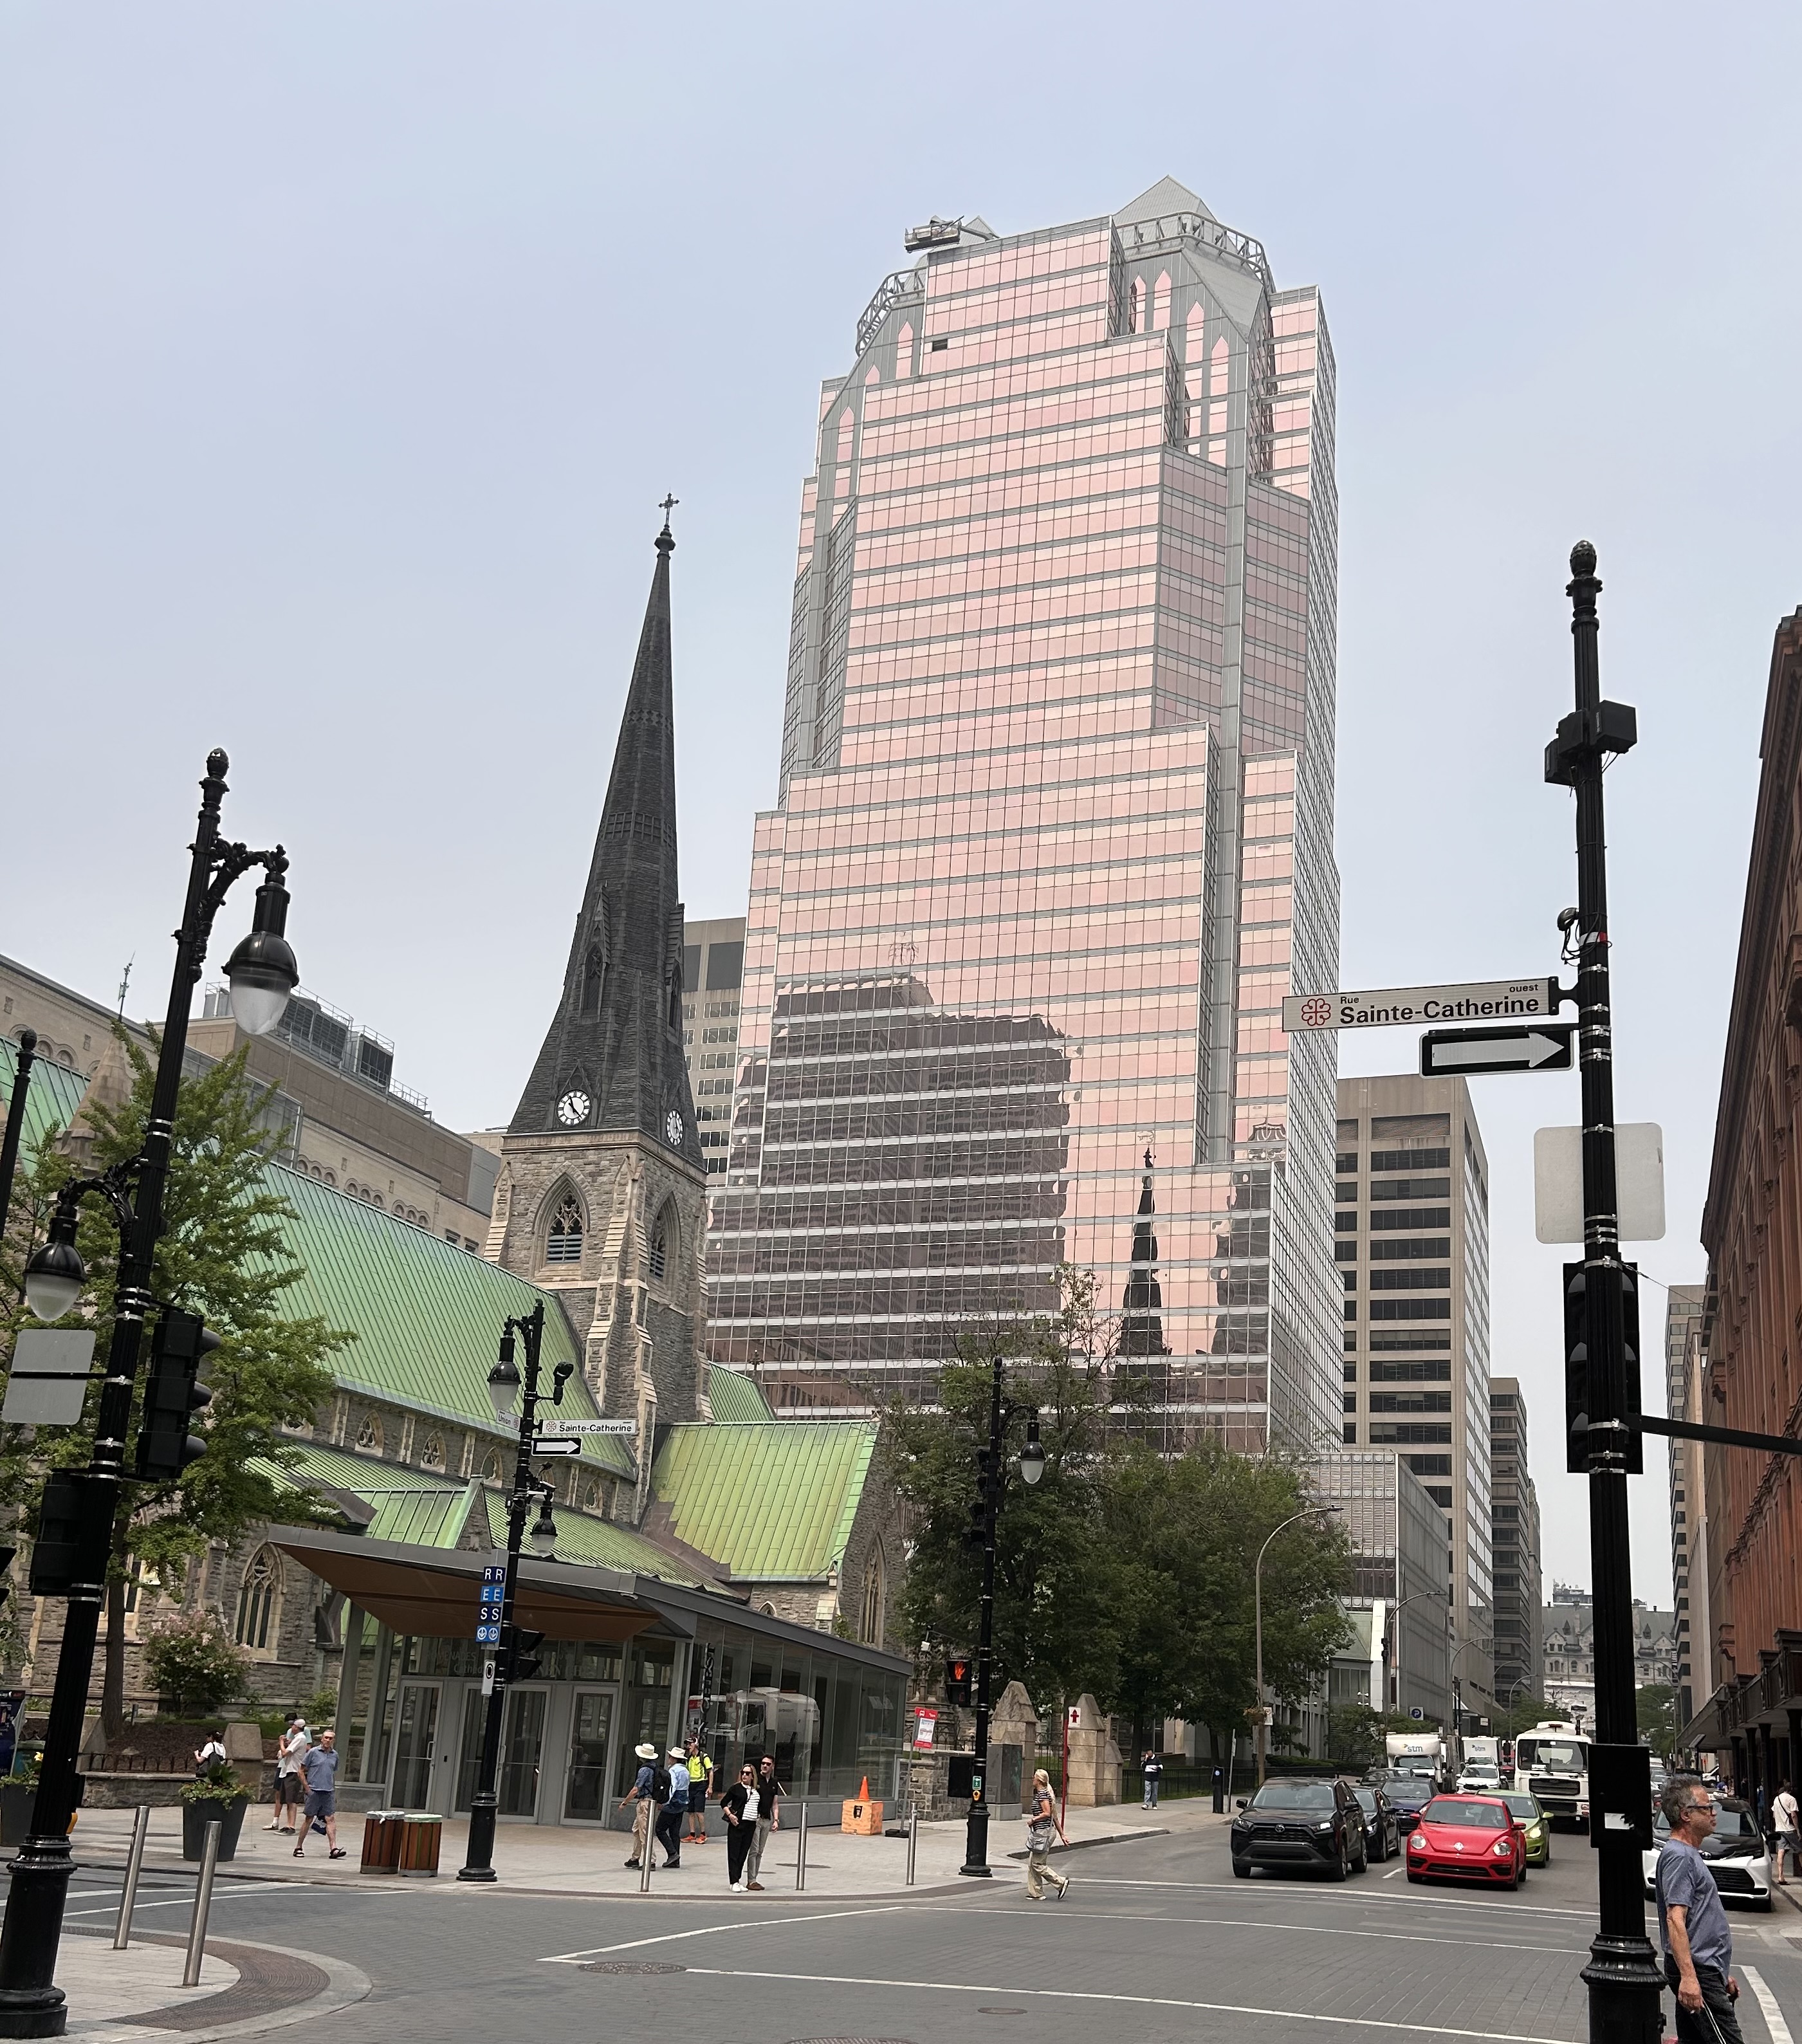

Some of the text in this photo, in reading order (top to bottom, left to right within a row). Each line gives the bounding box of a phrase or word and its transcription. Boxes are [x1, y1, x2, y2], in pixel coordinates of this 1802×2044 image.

[1509, 984, 1539, 993] ouest
[1340, 996, 1359, 1004] Rue
[1340, 995, 1540, 1024] Sainte-Catherine
[499, 1414, 511, 1425] Union
[559, 1424, 632, 1432] Sainte-Catherine
